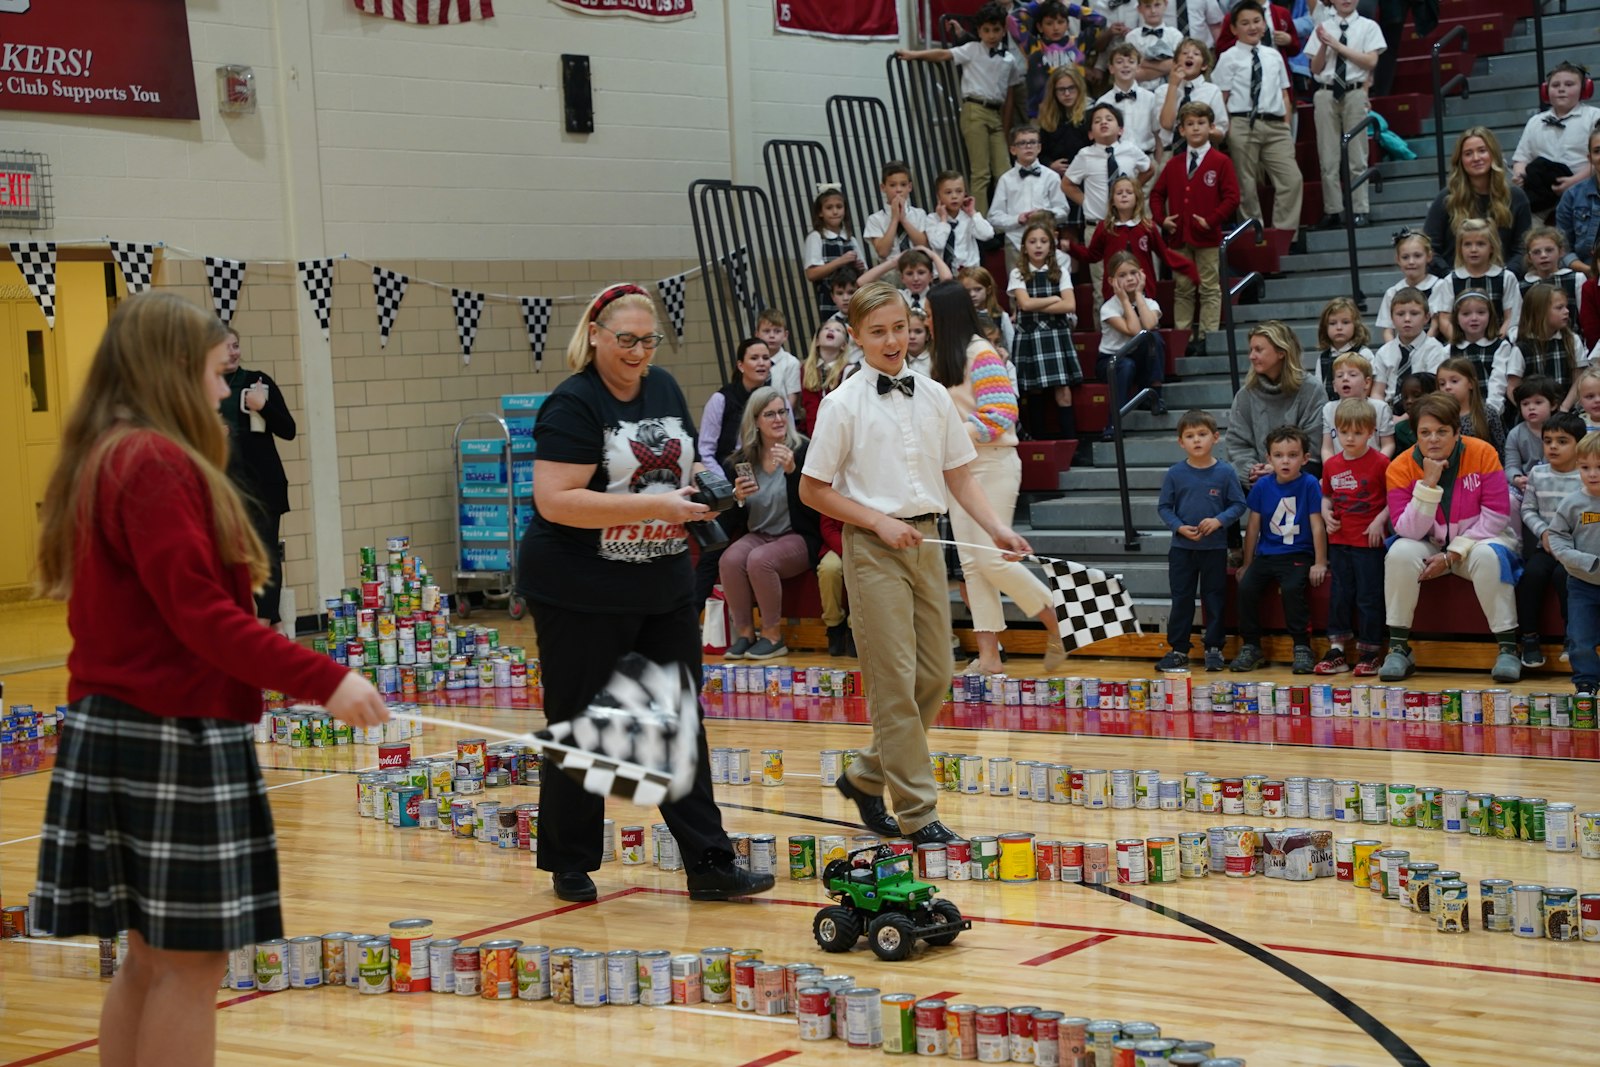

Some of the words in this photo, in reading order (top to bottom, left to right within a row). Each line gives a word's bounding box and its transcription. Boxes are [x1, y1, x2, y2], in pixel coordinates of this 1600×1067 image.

[7, 77, 49, 96] Club
[53, 80, 127, 103] Supports
[129, 85, 161, 103] You
[0, 173, 31, 207] EXIT
[604, 525, 640, 540] IT'S
[1269, 496, 1300, 545] 4
[1311, 852, 1333, 864] PINTO
